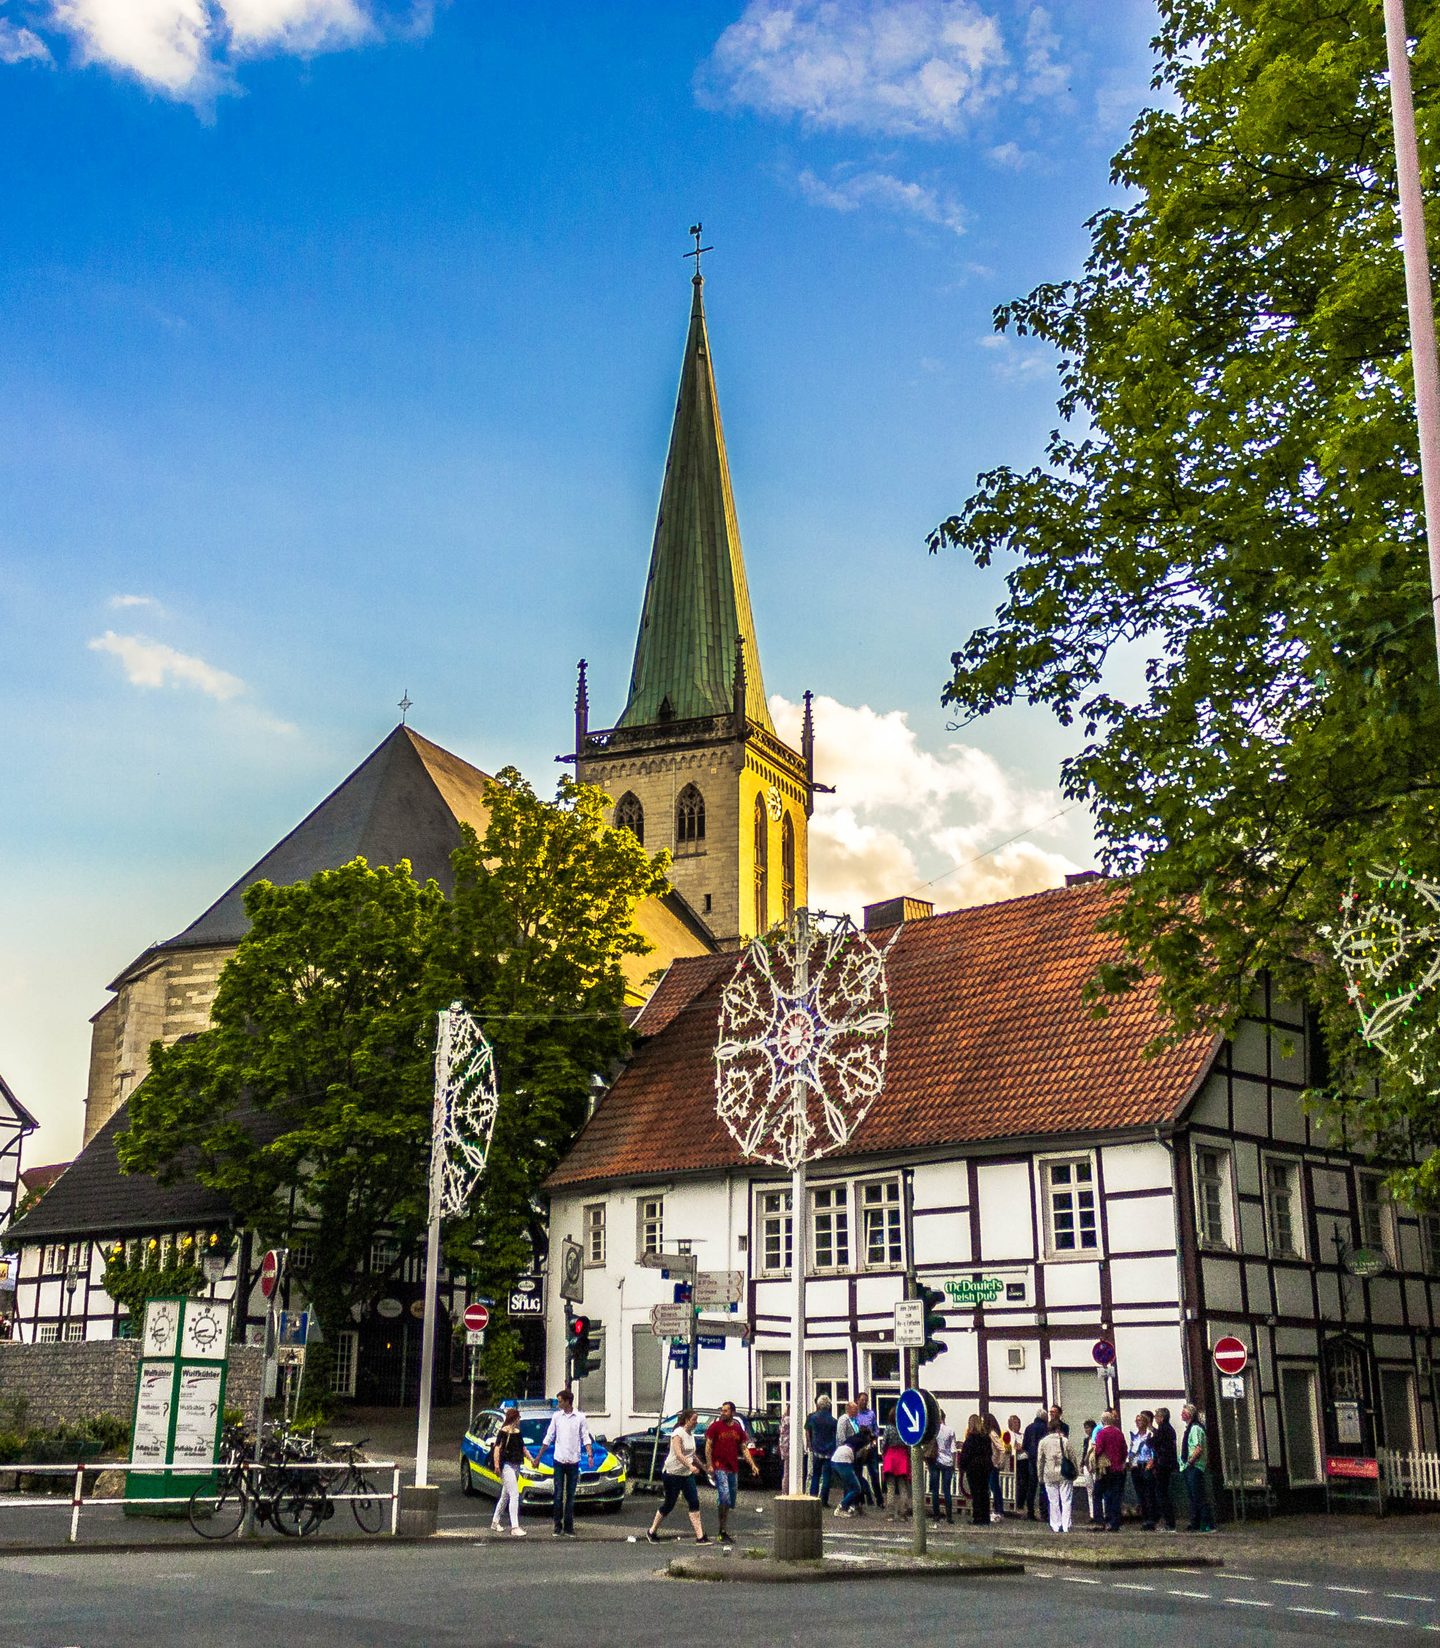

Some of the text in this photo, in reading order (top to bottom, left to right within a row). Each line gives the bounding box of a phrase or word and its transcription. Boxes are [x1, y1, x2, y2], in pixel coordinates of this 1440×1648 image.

[511, 1294, 541, 1312] Snug
[953, 1291, 997, 1304] Irish Pub
